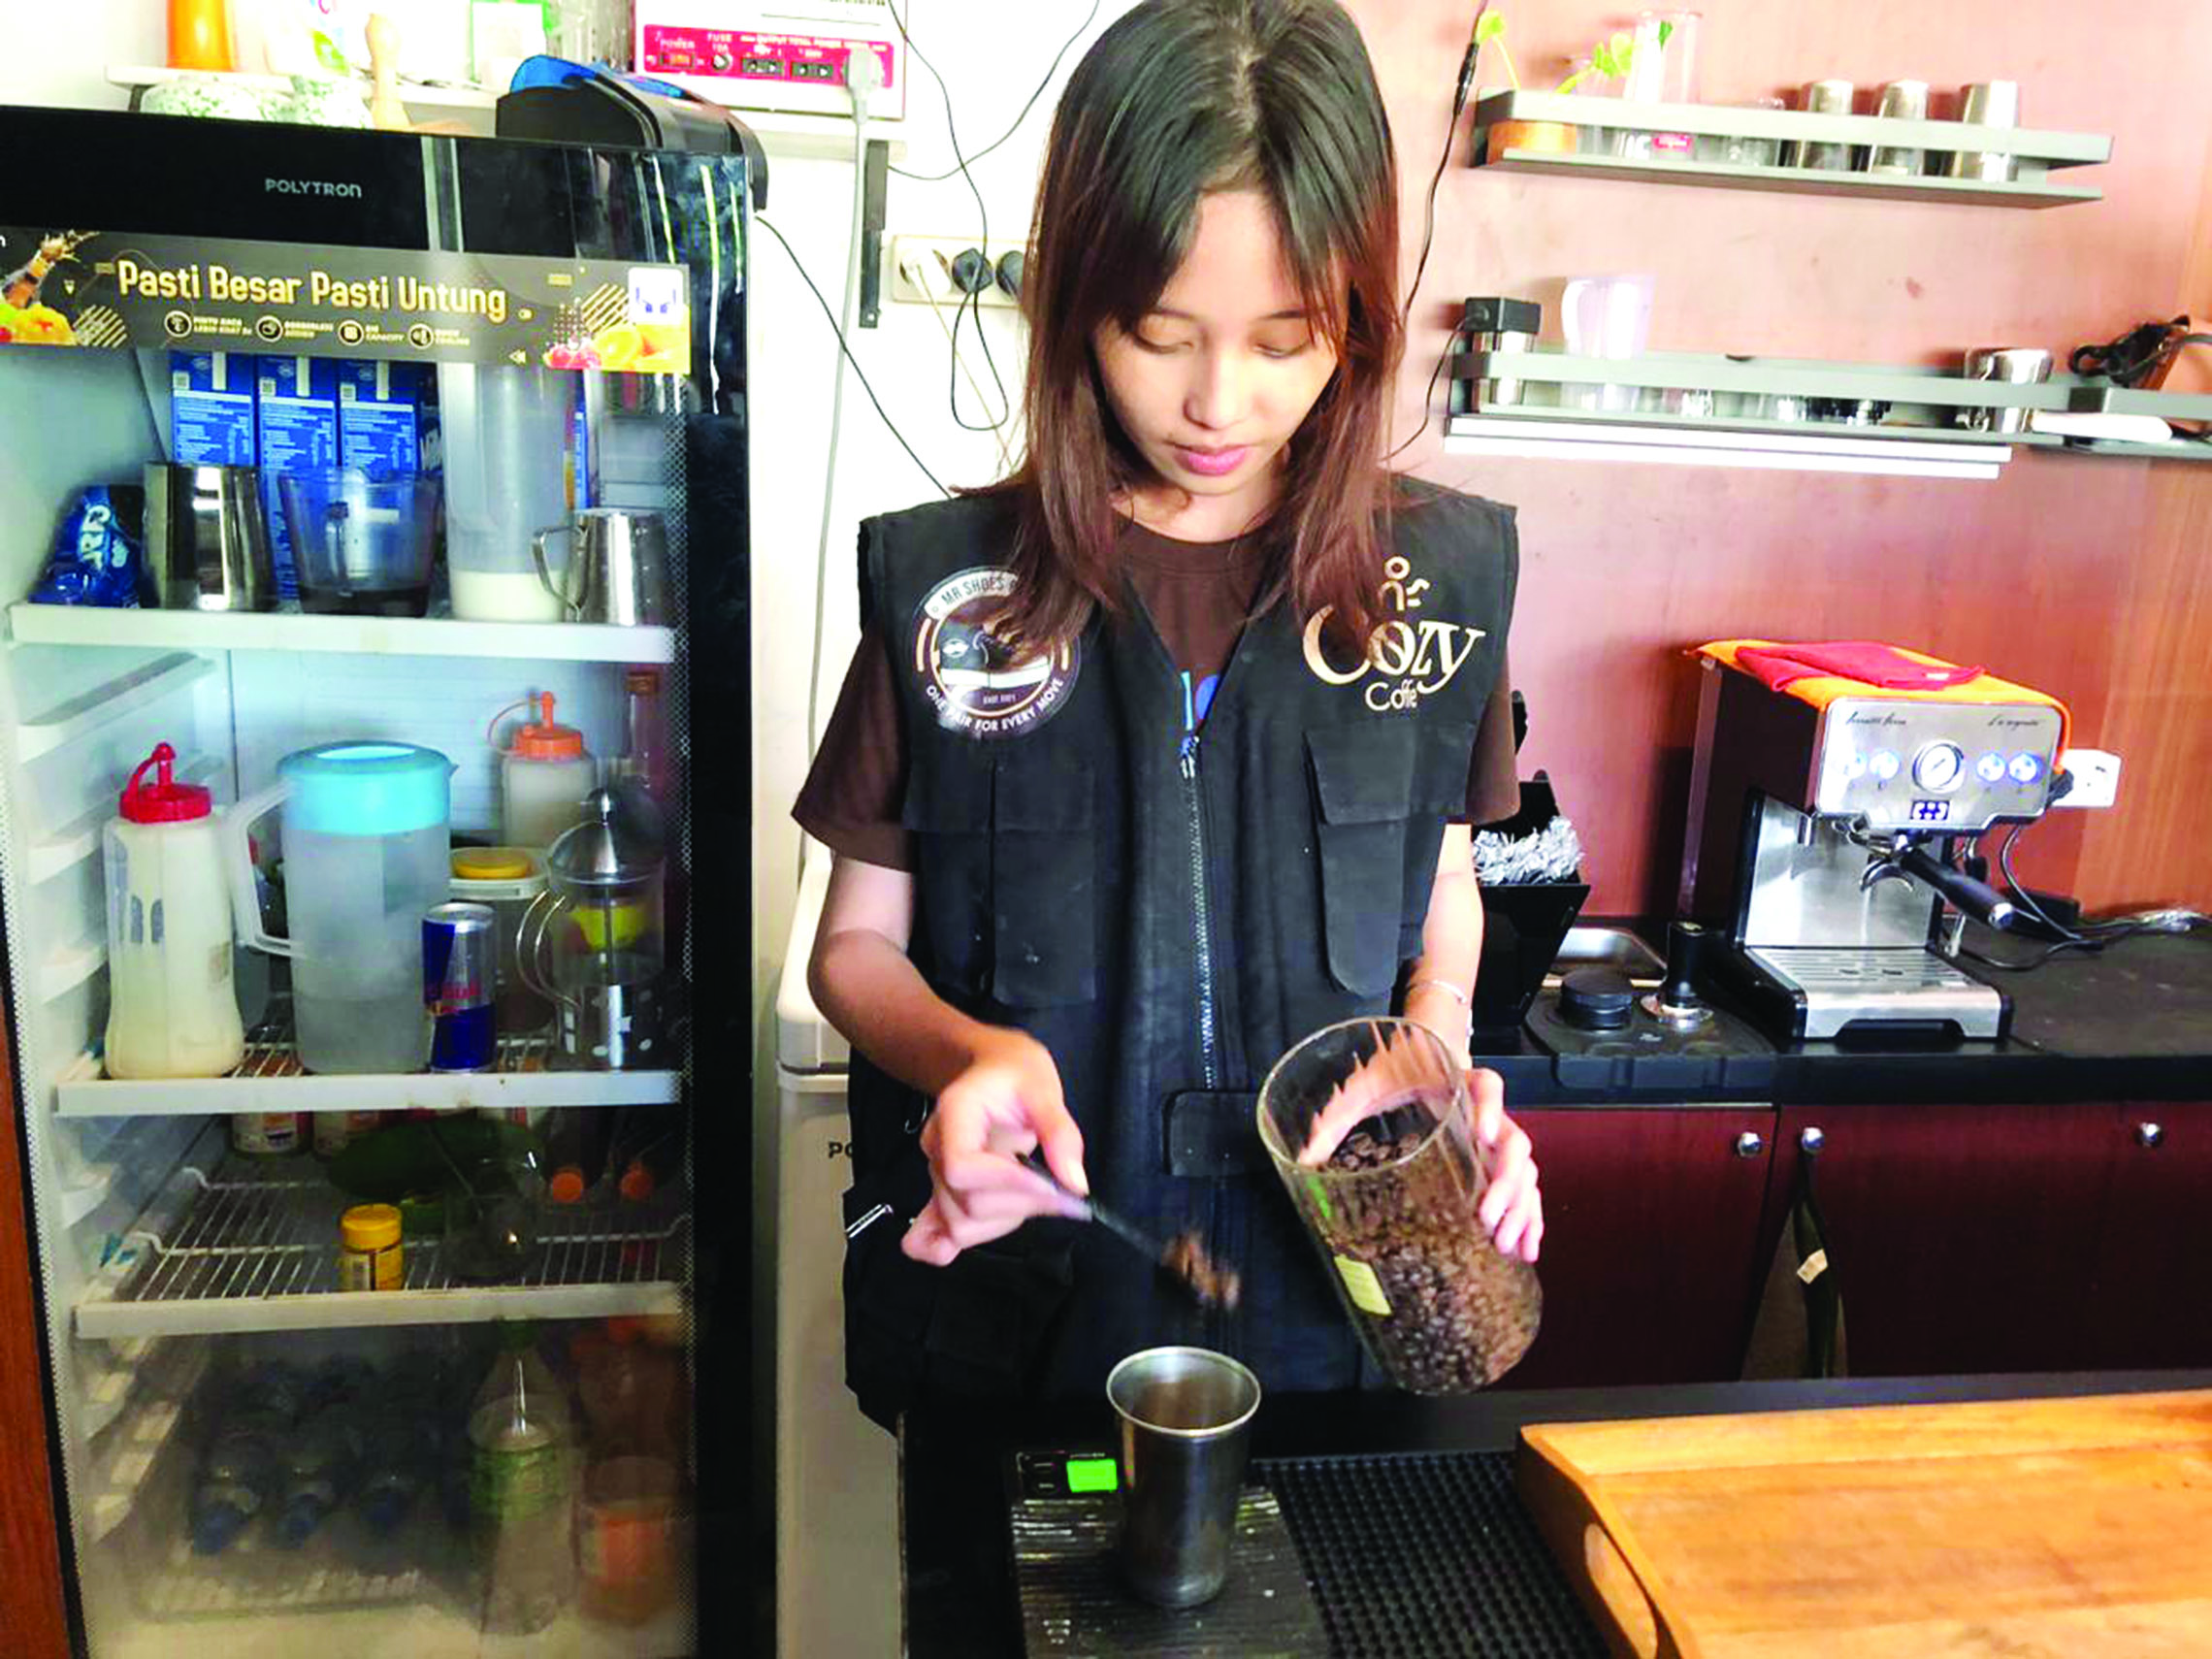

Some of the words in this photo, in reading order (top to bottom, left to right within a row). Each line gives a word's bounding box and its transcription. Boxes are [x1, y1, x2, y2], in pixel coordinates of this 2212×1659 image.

[265, 178, 362, 198] POLYTRON
[117, 260, 200, 300] Pasti
[208, 266, 303, 305] Besar
[310, 271, 389, 309] Pasti
[397, 276, 507, 324] Untung
[941, 586, 964, 606] MR
[963, 576, 1006, 594] SHOES
[926, 684, 947, 712] ONE
[974, 718, 999, 732] FOR
[1001, 705, 1037, 731] EVERY
[1035, 678, 1064, 714] MOVE
